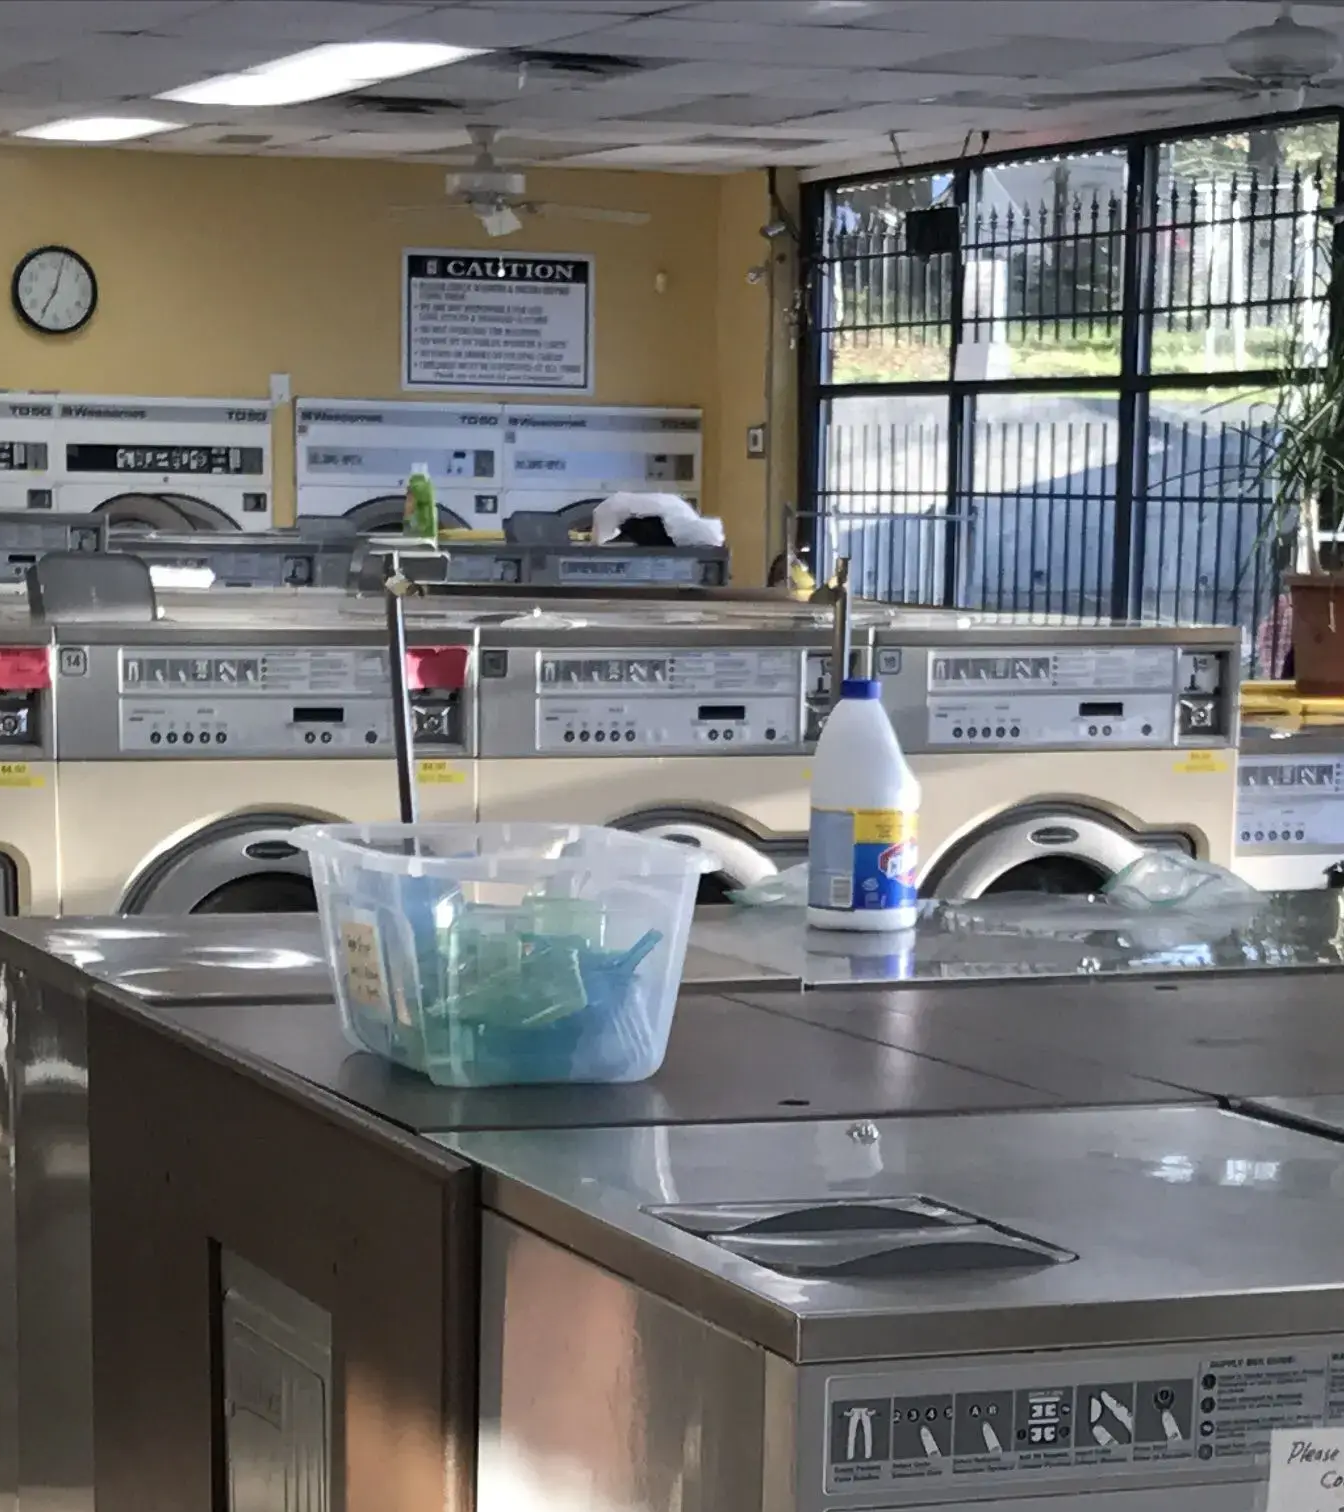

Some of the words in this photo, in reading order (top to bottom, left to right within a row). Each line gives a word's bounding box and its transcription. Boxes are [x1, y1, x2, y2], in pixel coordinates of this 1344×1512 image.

[446, 259, 575, 280] CAUTION
[67, 655, 82, 667] 14
[1287, 1440, 1340, 1464] Please
